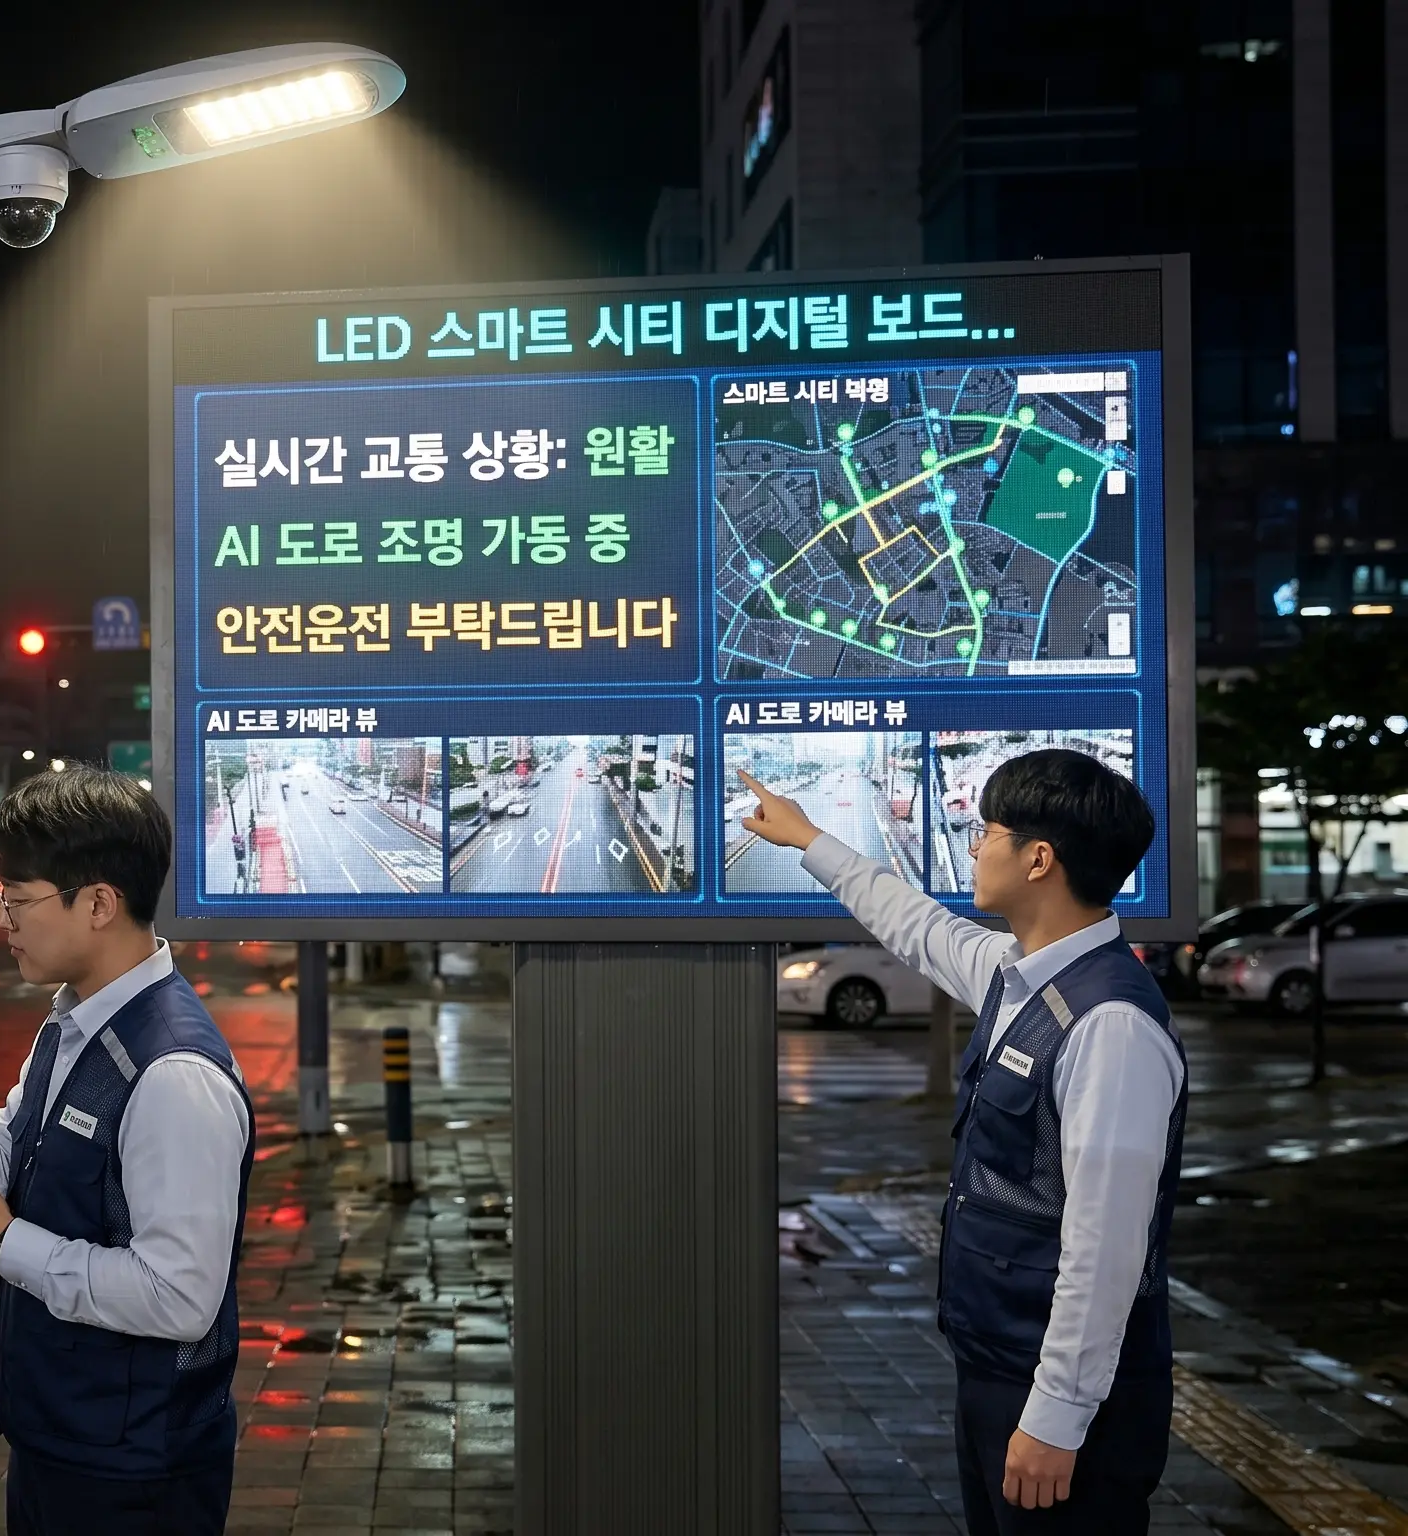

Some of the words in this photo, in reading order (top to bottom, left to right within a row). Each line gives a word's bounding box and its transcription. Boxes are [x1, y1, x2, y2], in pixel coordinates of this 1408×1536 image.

[318, 316, 410, 362] LED
[428, 308, 572, 360] 스마트
[588, 302, 681, 356] 시티
[706, 295, 848, 352] 디지털
[868, 293, 1014, 341] 보드...
[723, 382, 789, 404] 스마트
[794, 379, 838, 404] 시티
[215, 436, 347, 487] 실시간
[361, 433, 448, 482] 교통
[462, 429, 565, 480] 상황:
[584, 426, 674, 476] 원활
[215, 525, 259, 566] AI
[276, 522, 362, 564] 도로
[378, 518, 462, 566] 조명
[482, 516, 570, 564] 가동
[585, 514, 630, 562] 중
[217, 604, 390, 653] 안전운전
[407, 598, 677, 651] 부탁드립니다
[207, 711, 229, 731] AI
[236, 710, 279, 731] 도로
[286, 708, 350, 732] 카메라
[356, 708, 377, 732] 뷰
[726, 704, 749, 724] AI
[757, 702, 802, 724] 도로
[809, 700, 877, 726] 카메라
[884, 701, 907, 725] 뷰
